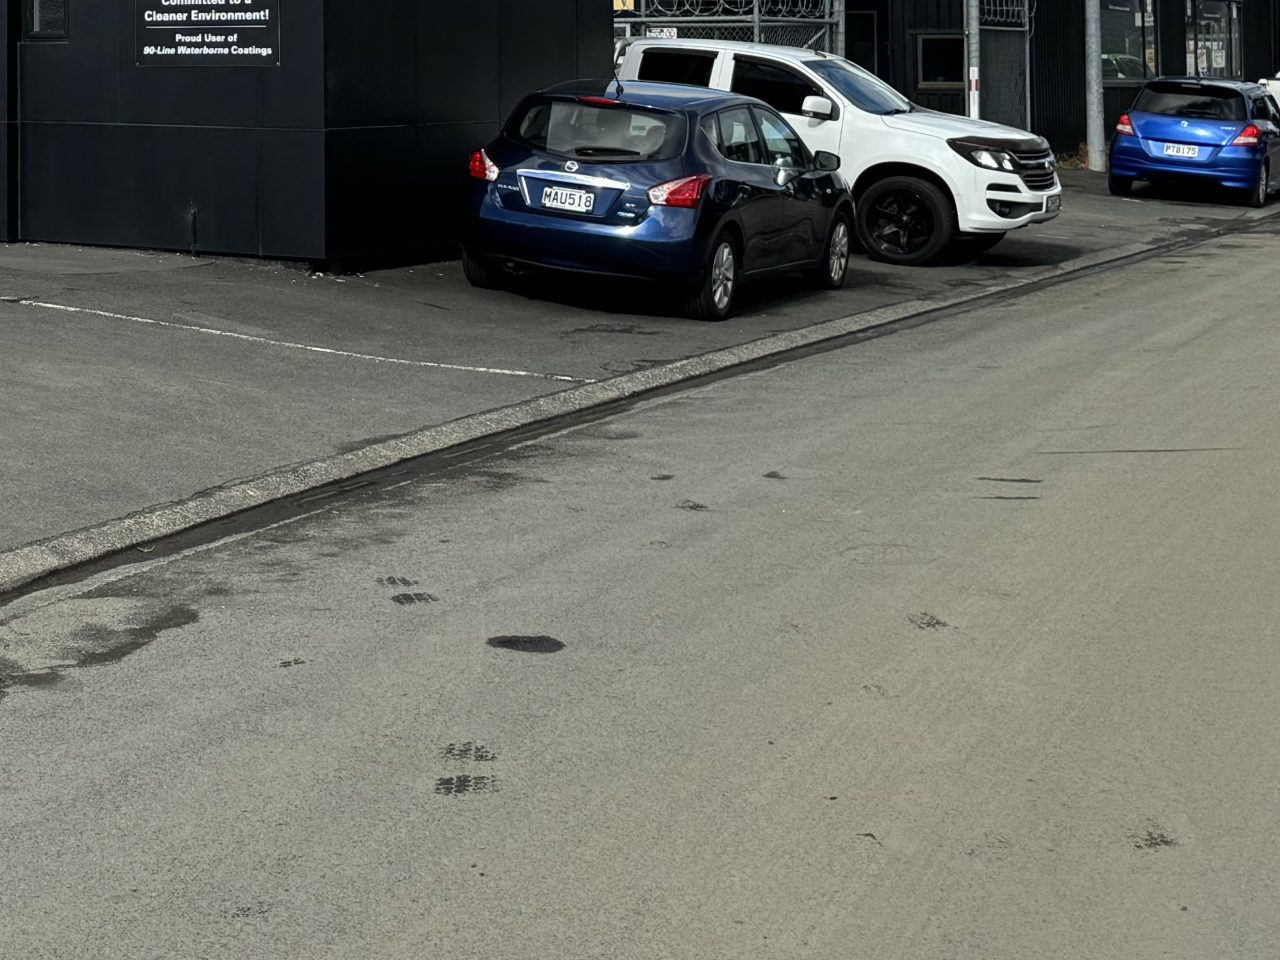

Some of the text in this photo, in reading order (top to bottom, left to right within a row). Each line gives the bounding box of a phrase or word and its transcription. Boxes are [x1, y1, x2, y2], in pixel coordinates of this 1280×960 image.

[144, 9, 270, 22] Cleaner Environment!
[175, 33, 238, 43] Proud User of
[143, 45, 272, 56] 90-Line Waterborne Coatings
[544, 188, 593, 208] MAU518
